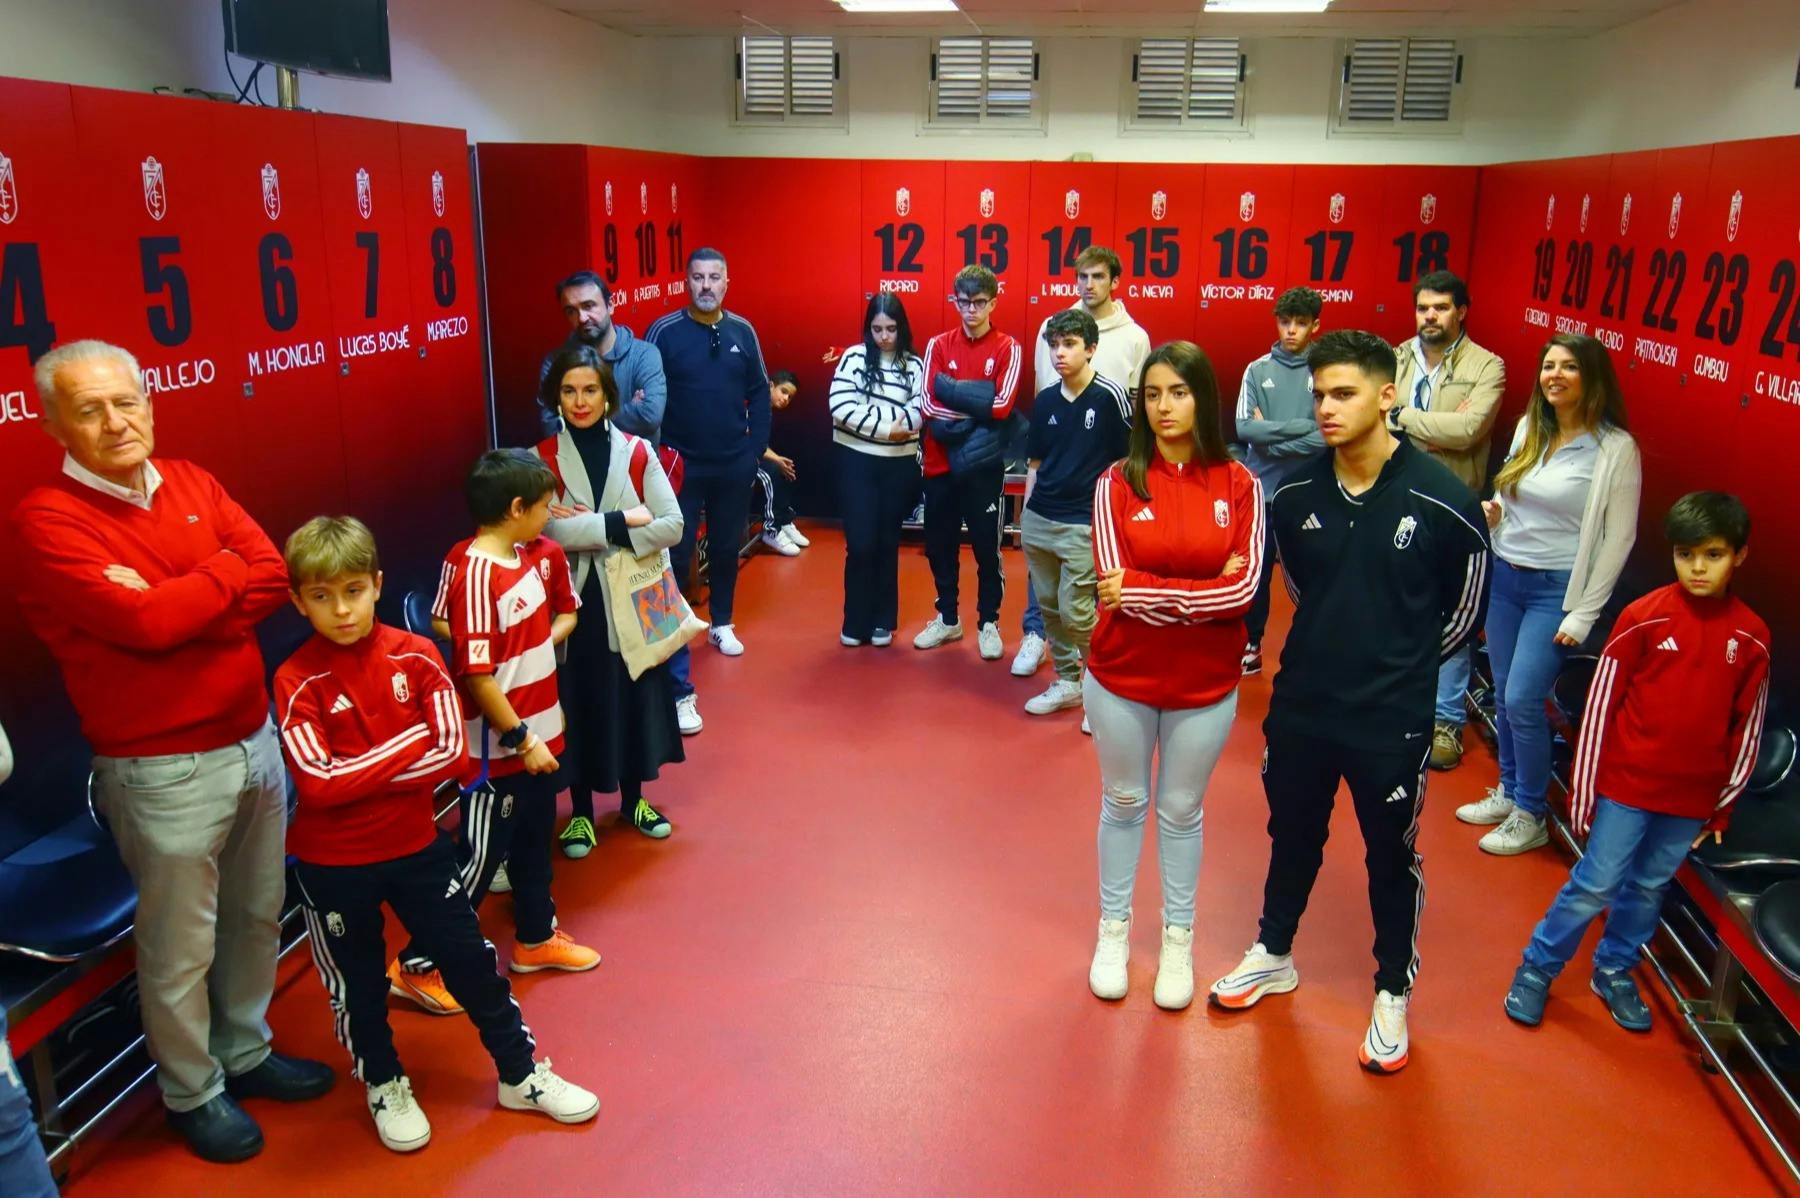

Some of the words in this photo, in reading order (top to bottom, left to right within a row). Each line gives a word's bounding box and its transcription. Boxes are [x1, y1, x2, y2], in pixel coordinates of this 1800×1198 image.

[431, 227, 457, 307] 8
[604, 223, 618, 284] 9
[634, 221, 656, 278] 10
[667, 220, 683, 273] 11
[874, 223, 925, 273] 12
[956, 223, 1009, 274] 13
[1041, 226, 1092, 275] 14
[1125, 226, 1180, 278] 15
[1213, 227, 1269, 279] 16
[1304, 230, 1355, 282] 17
[1393, 230, 1450, 282] 18
[1531, 237, 1556, 303] 19
[138, 236, 192, 347] 5
[258, 232, 299, 332] 6
[355, 231, 379, 319] 7
[879, 279, 919, 293] RICARD
[1041, 283, 1047, 296] I.
[1050, 283, 1080, 297] MIQUE
[1128, 285, 1139, 297] C.
[1142, 286, 1173, 298] NEVA
[1201, 284, 1244, 300] VÍCTOR
[1248, 284, 1275, 300] DÍAZ
[1560, 239, 1593, 311] 20
[1600, 244, 1636, 321] 21
[1642, 248, 1687, 333] 22
[1695, 252, 1749, 346] 23
[0, 242, 57, 366] 4
[249, 354, 264, 376] M.
[266, 341, 325, 369] HONGLA
[1694, 354, 1729, 382] GUMBAU
[1755, 371, 1764, 394] G.
